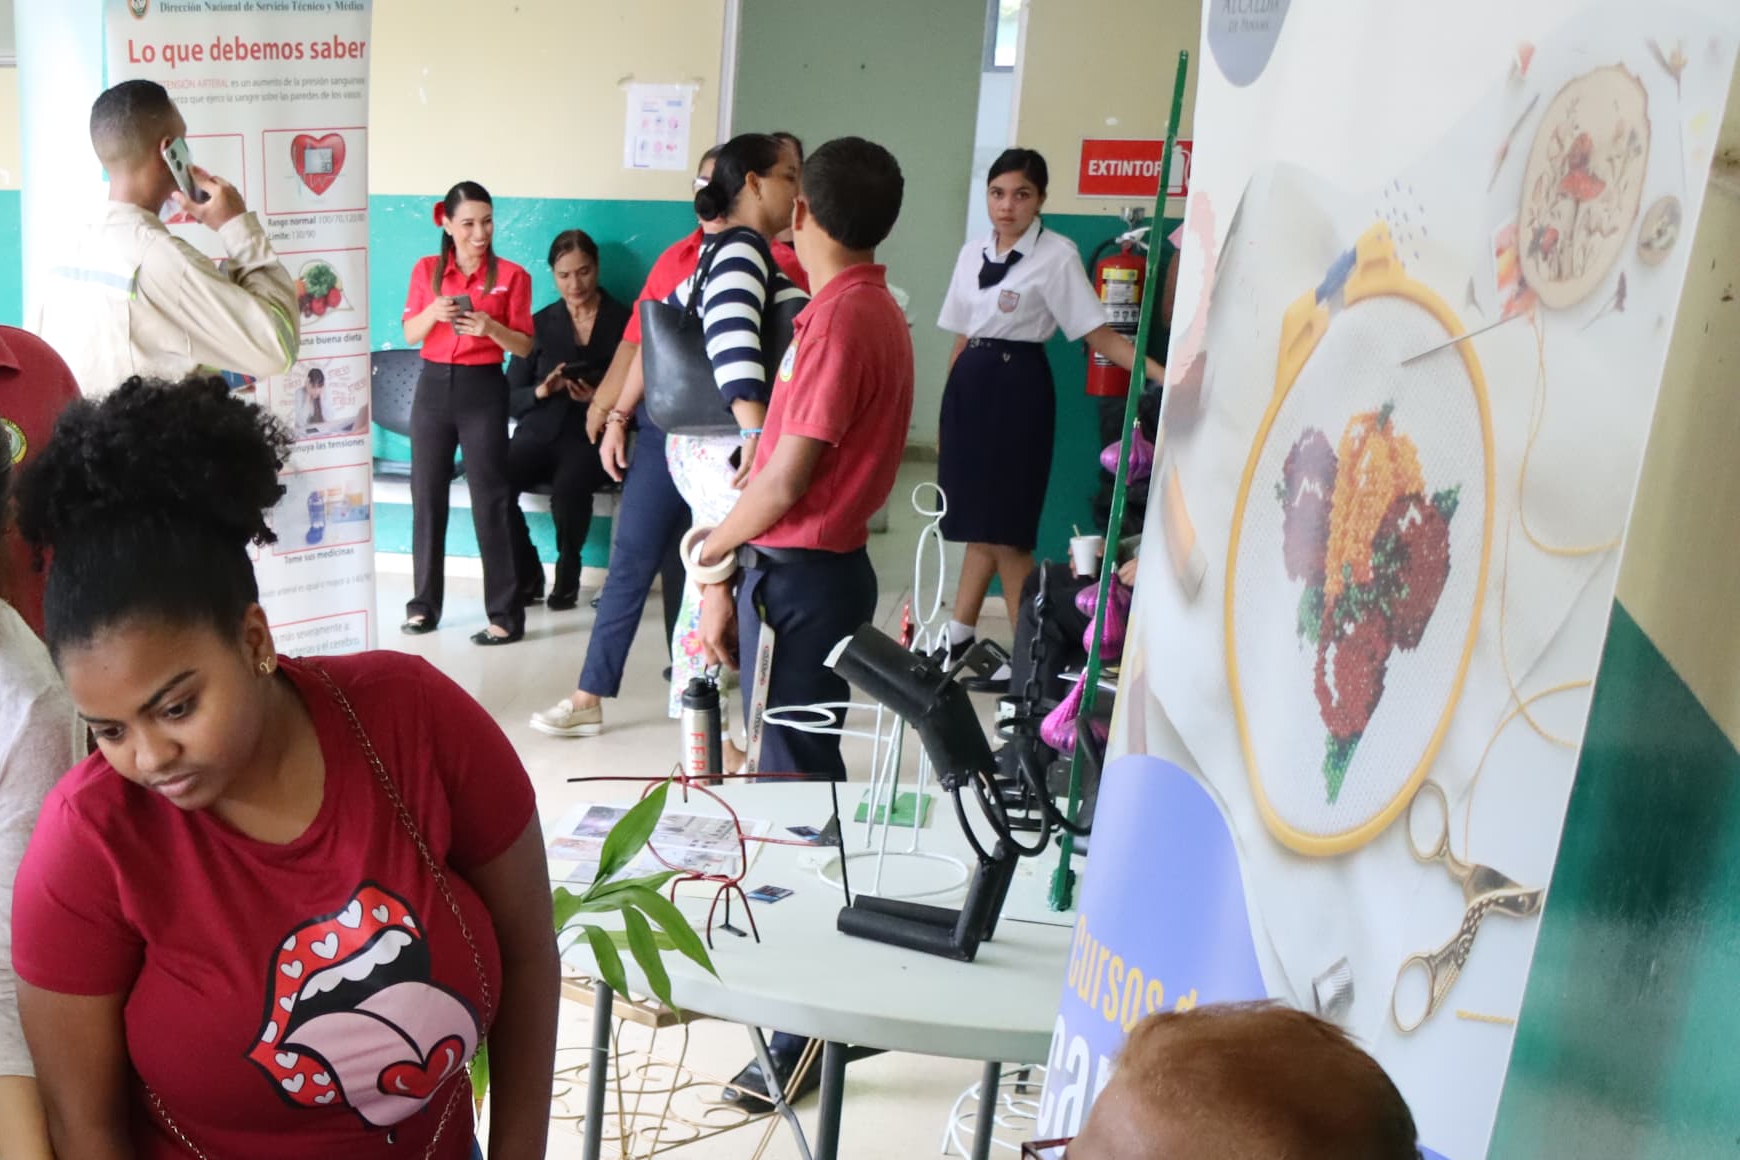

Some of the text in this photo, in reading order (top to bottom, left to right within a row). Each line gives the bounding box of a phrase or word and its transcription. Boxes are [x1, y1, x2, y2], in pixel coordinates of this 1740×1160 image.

[160, 1, 202, 13] Dirección
[204, 1, 242, 12] Nacional
[243, 1, 255, 12] de
[256, 1, 289, 11] Servicio
[128, 34, 366, 69] Lo que debemos saber
[315, 335, 342, 345] buena
[343, 333, 363, 342] dieta
[316, 547, 354, 560] medicinas
[690, 731, 709, 786] FER
